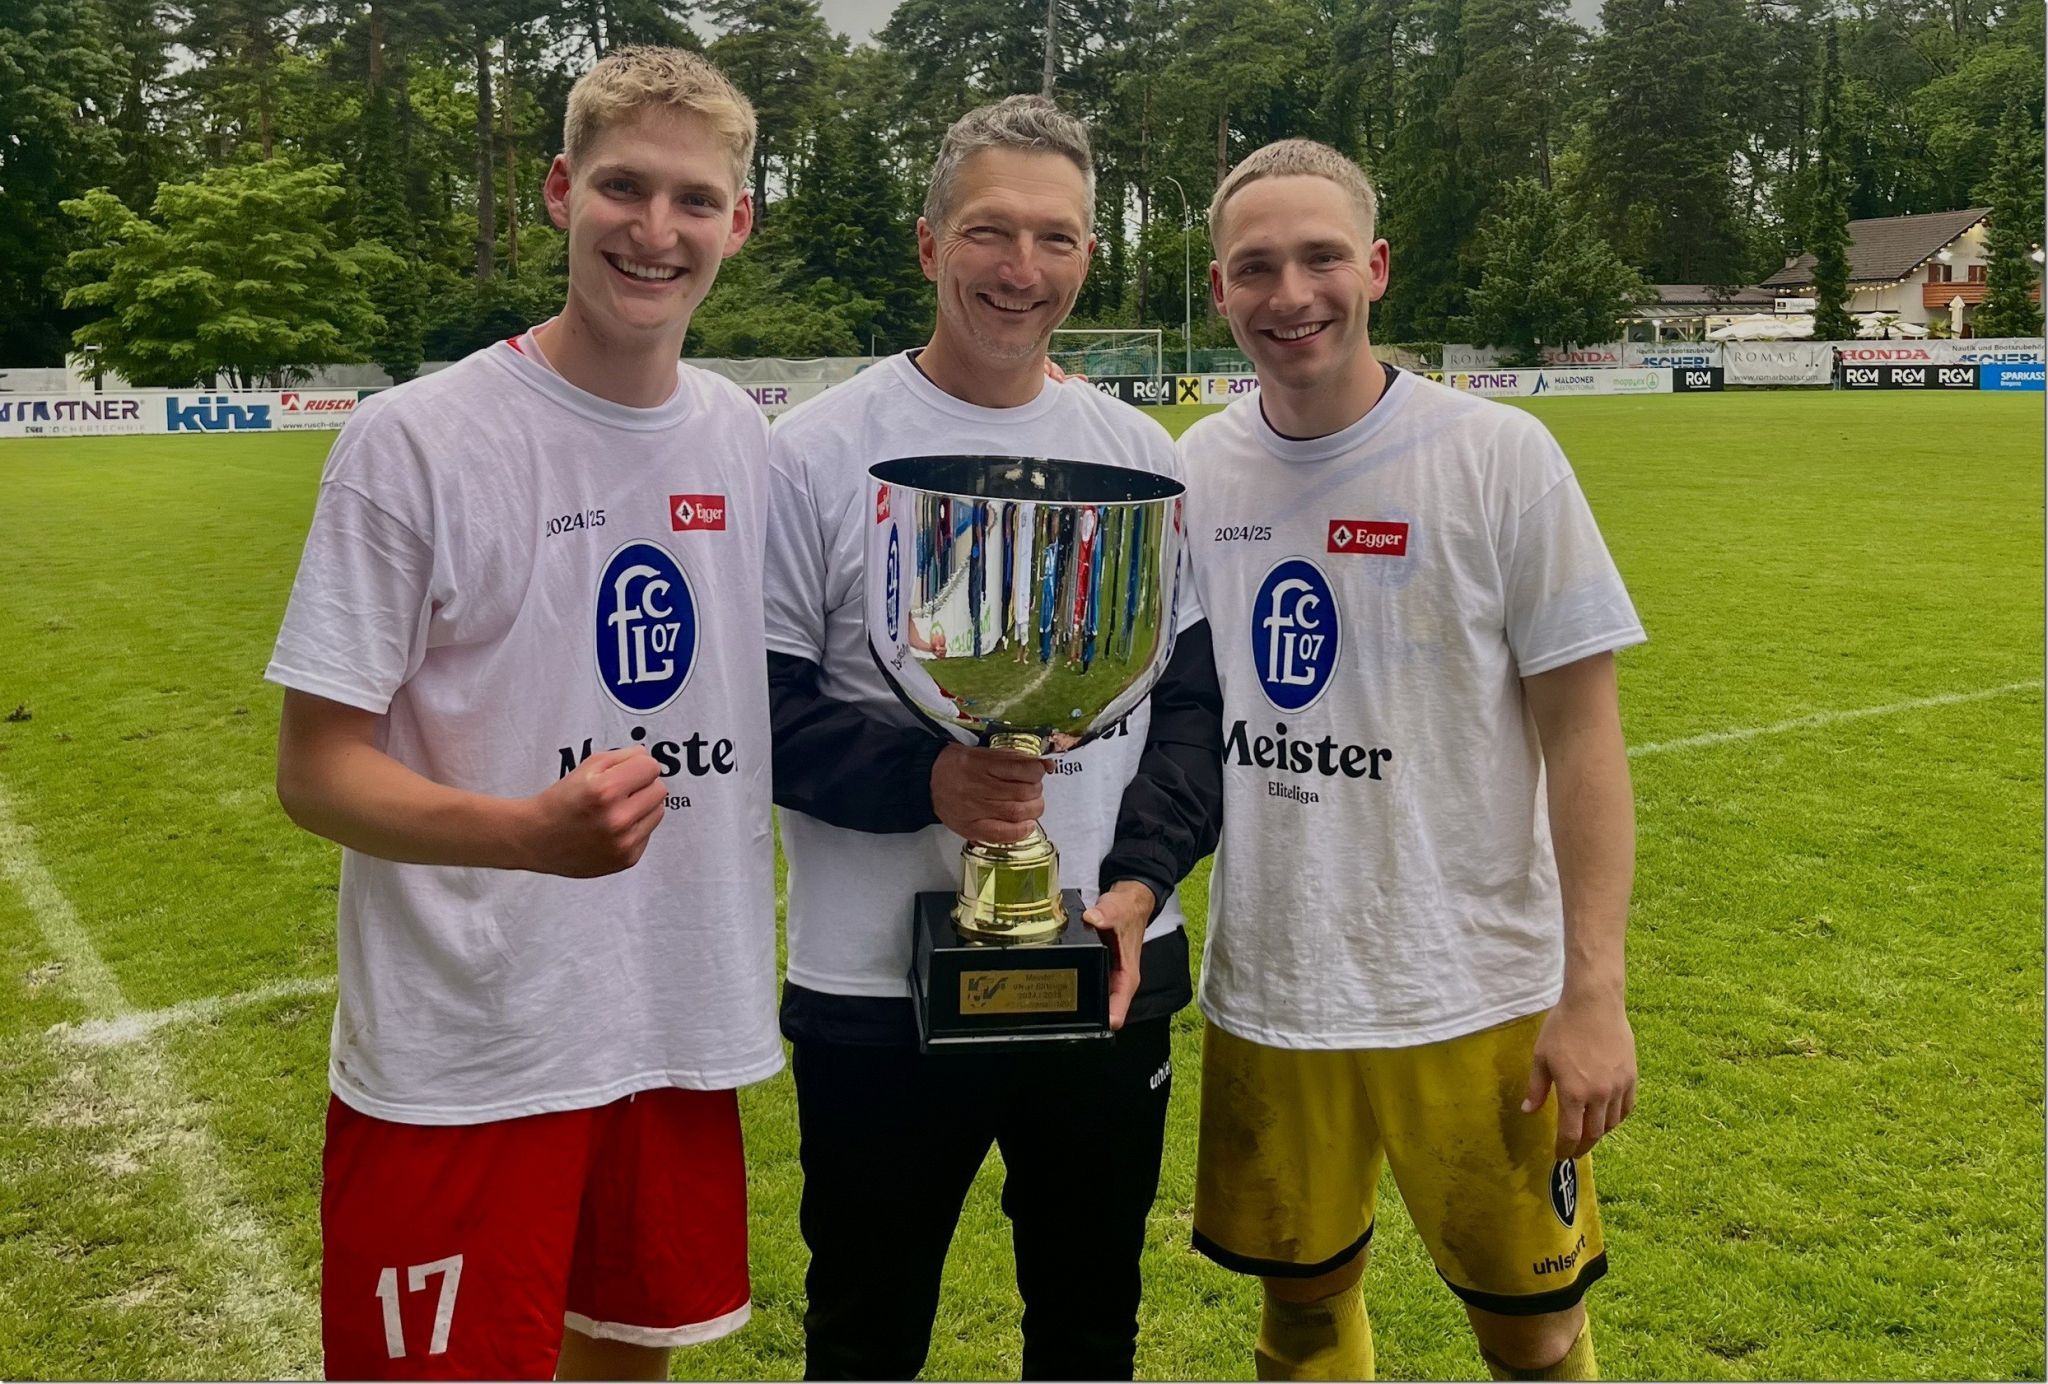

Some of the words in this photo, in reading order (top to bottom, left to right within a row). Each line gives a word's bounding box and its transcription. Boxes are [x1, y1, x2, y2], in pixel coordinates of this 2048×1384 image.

[1734, 351, 1798, 362] ROMAR
[1842, 349, 1931, 360] HONDA
[1555, 376, 1594, 384] MALDONER
[1686, 371, 1711, 386] RGM
[1846, 368, 1879, 383] RGM
[1891, 368, 1925, 383] RGM
[1938, 368, 1974, 383] RGM
[1096, 382, 1120, 398] GM
[1133, 381, 1170, 398] RGM
[304, 399, 355, 411] RUSCH
[166, 396, 272, 431] künz
[1214, 525, 1272, 542] 2024/25
[1355, 529, 1402, 548] Egger
[1223, 720, 1392, 781] Meister
[1268, 780, 1320, 804] Eliteliga
[375, 1254, 464, 1359] 17
